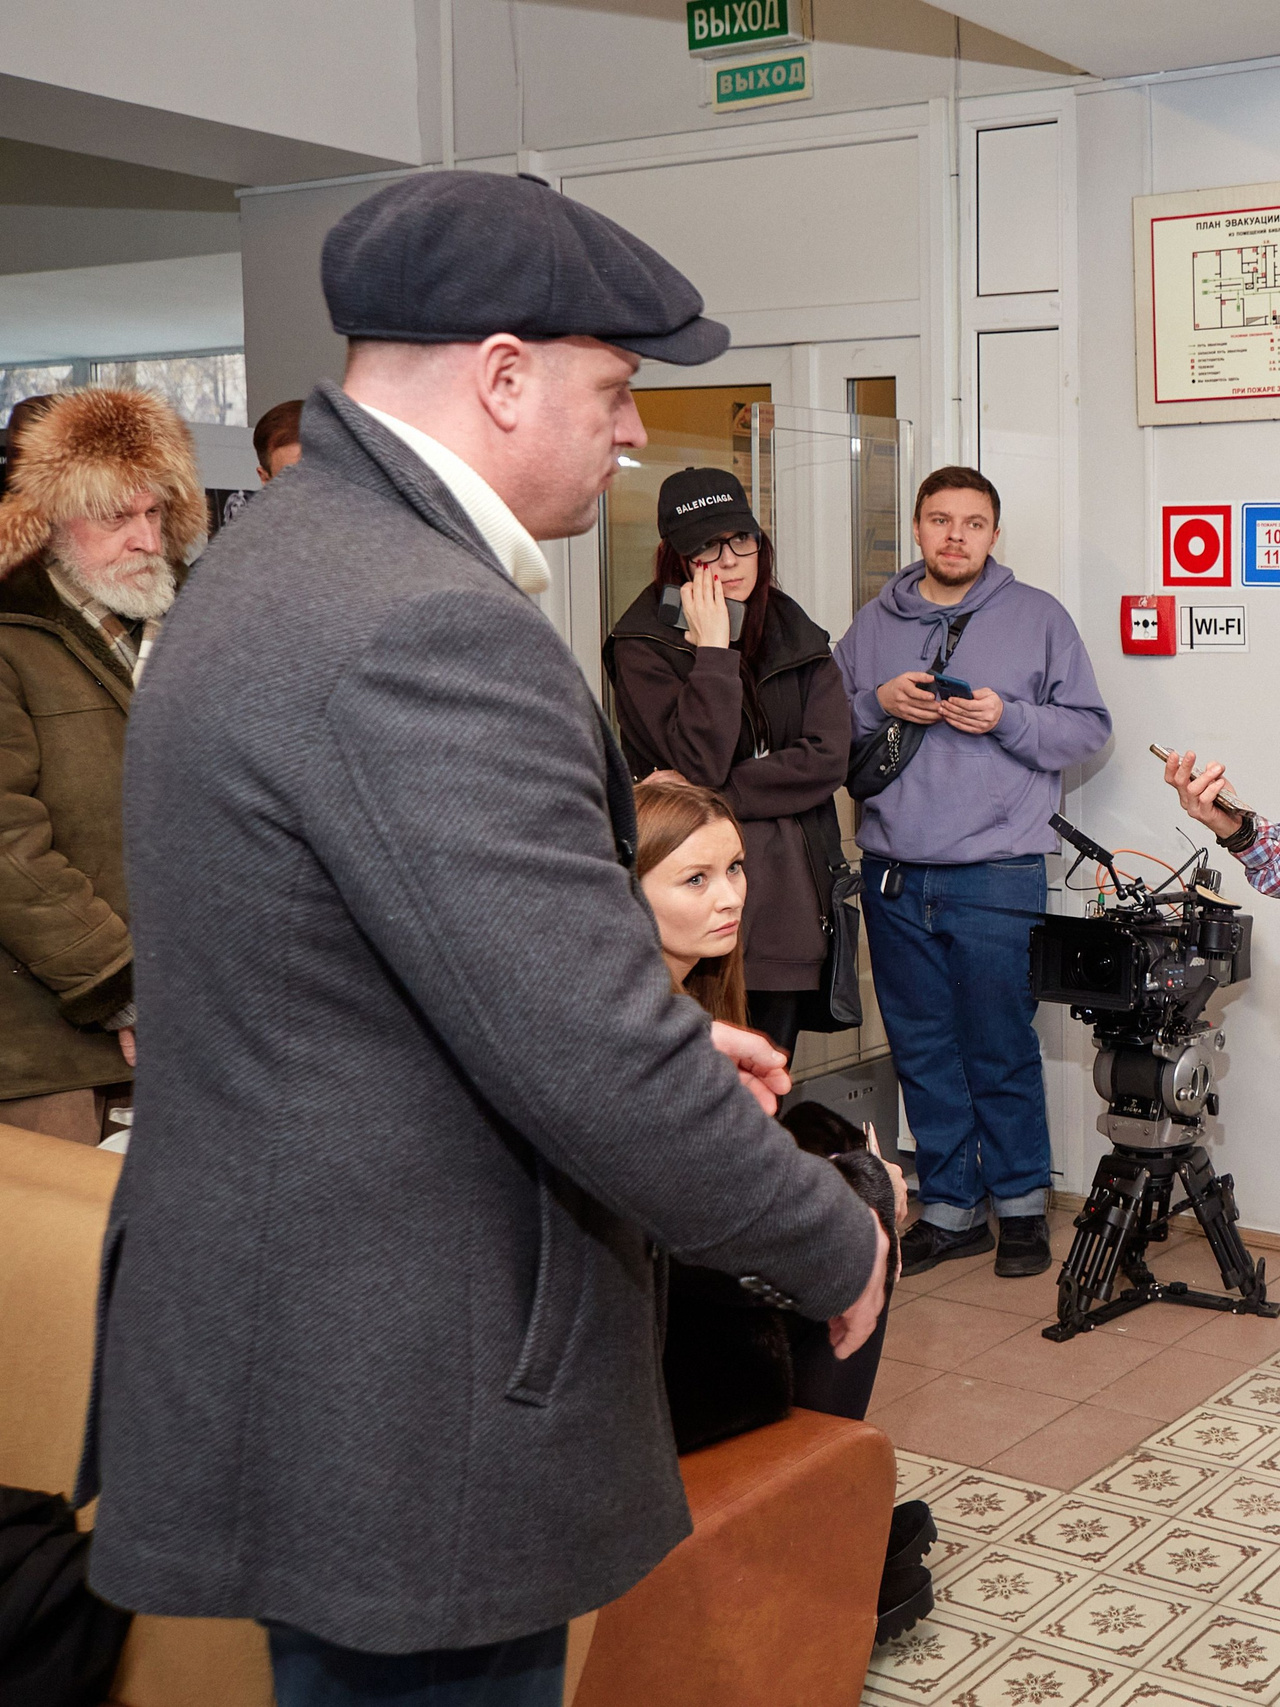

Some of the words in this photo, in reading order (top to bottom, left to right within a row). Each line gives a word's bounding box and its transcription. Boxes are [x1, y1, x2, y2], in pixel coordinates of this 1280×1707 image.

[694, 0, 780, 40] ВЫХОД
[720, 62, 804, 95] ВЫХОД
[1196, 218, 1221, 231] ПЛАН
[1225, 215, 1280, 228] ЭВАКУАЦИИ
[1247, 386, 1276, 394] ПОЖАРЕ
[676, 494, 734, 514] BALENCIAGA
[1195, 618, 1241, 635] WI-FI
